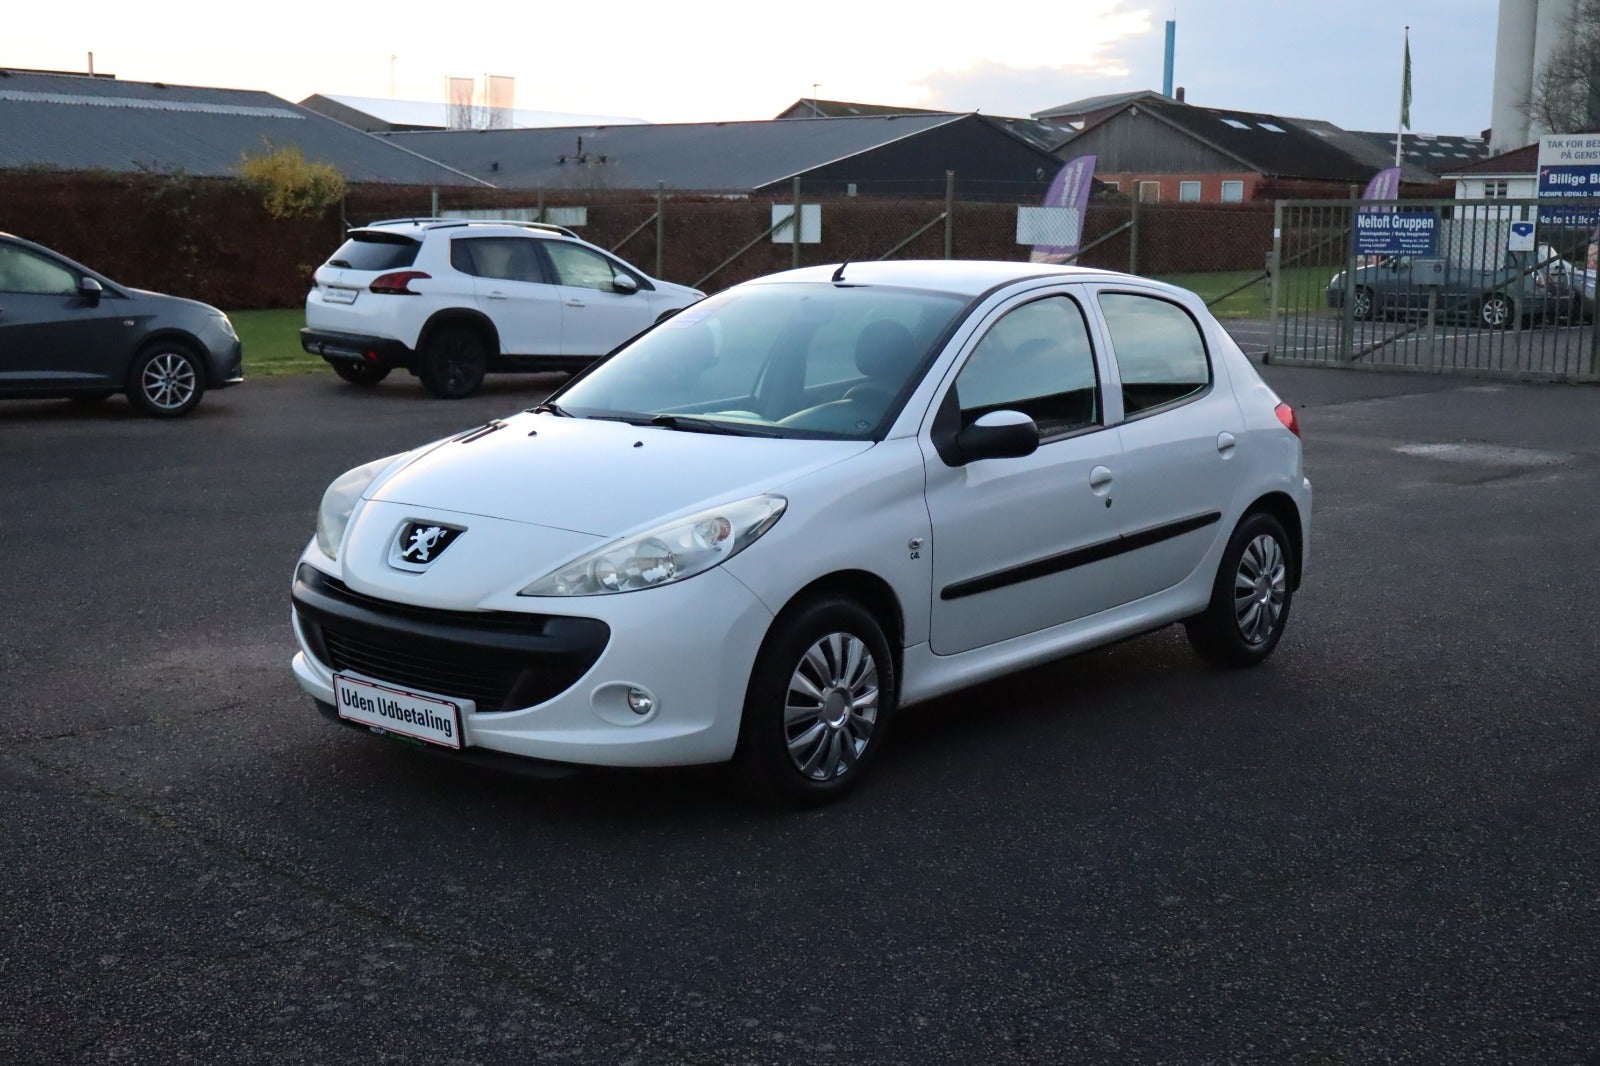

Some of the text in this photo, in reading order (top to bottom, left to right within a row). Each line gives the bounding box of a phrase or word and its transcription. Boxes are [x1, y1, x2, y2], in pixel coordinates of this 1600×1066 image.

[1566, 140, 1583, 148] FOR
[1560, 151, 1600, 159] PÅ GENS
[1549, 173, 1586, 186] Billige
[1358, 214, 1434, 231] Neltoft Gruppen
[341, 687, 452, 738] Uden Udbetaling
